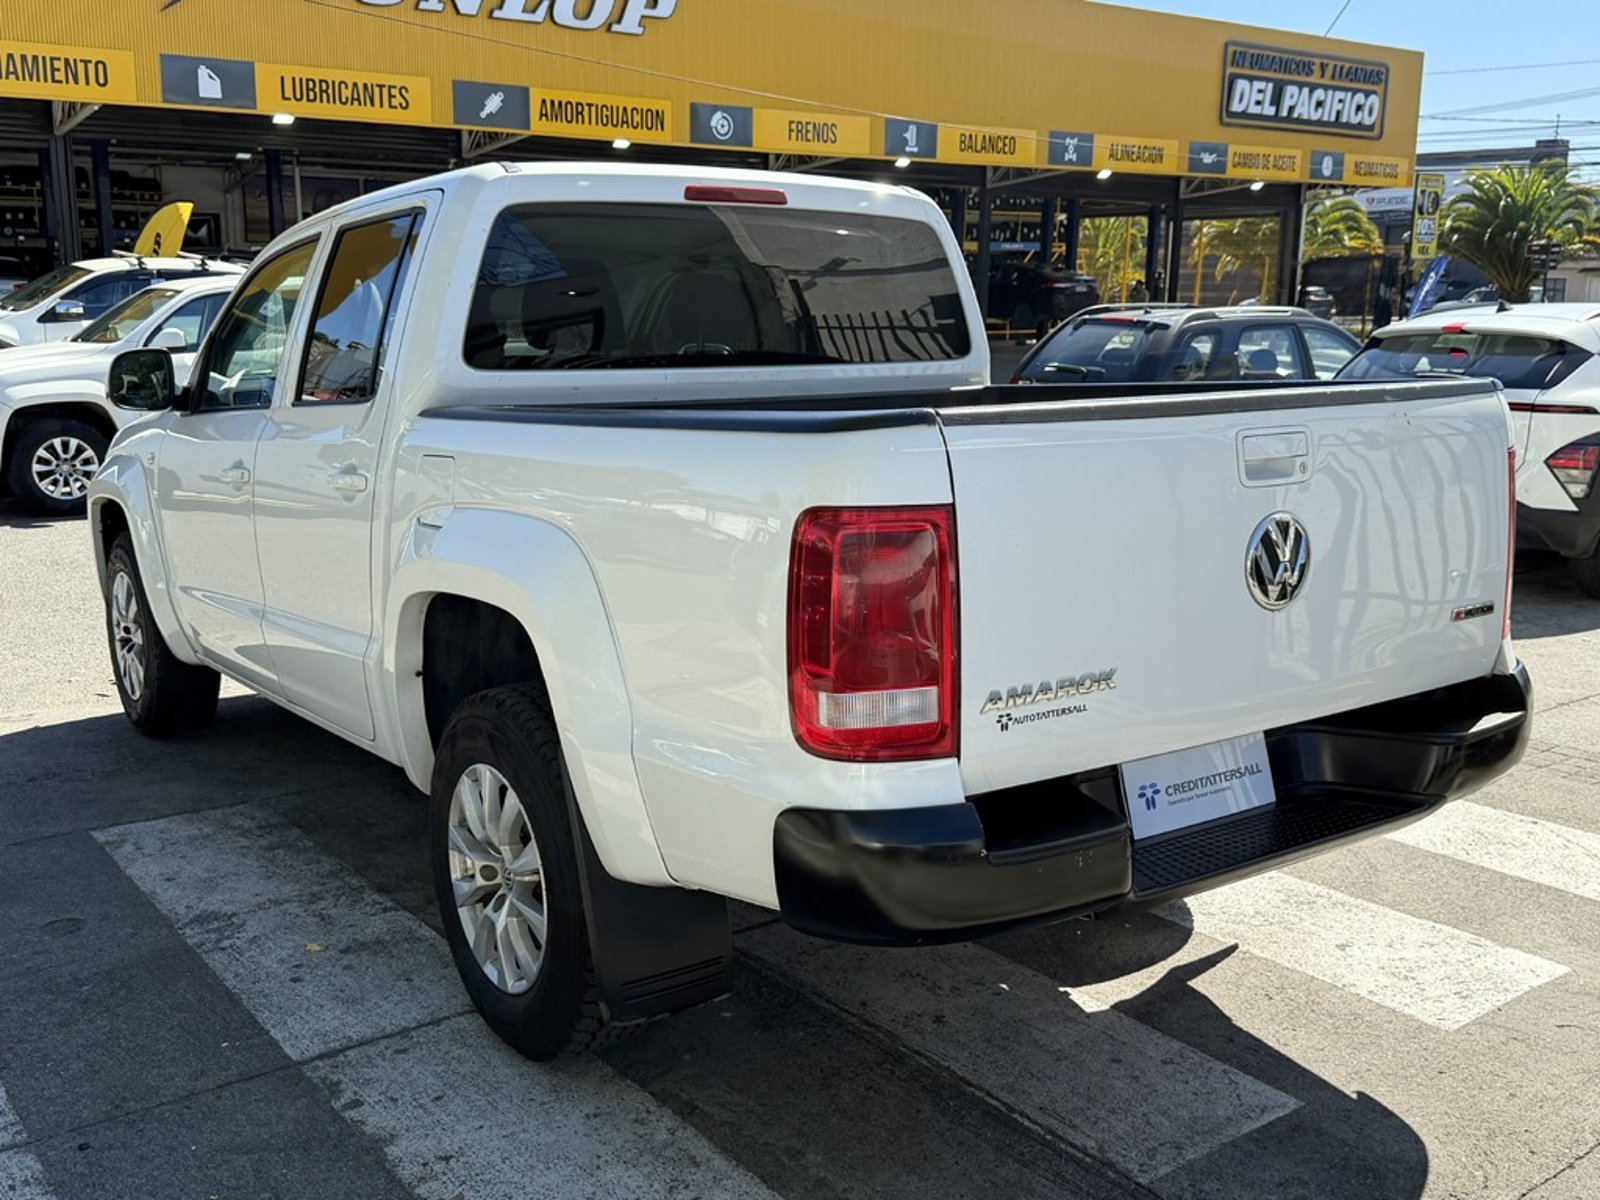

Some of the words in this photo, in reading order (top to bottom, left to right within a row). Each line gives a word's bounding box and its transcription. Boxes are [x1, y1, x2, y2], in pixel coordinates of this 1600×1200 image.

[0, 52, 109, 88] AMIENTO
[1232, 50, 1315, 78] NEUMATICOS
[1319, 61, 1330, 79] Y
[1331, 63, 1385, 86] LLANTAS
[279, 75, 410, 111] LUBRICANTES
[1229, 78, 1277, 116] DEL
[1278, 85, 1380, 126] PACIFICO
[538, 98, 666, 132] AMORTIGUACION
[788, 120, 838, 145] FRENOS
[959, 132, 1017, 156] BALANCEO
[1108, 143, 1165, 165] ALINEACION
[1232, 151, 1260, 170] CAMBIO
[1261, 152, 1271, 171] DE
[1272, 154, 1297, 173] ACEITE
[1353, 160, 1399, 180] NEUMATICOS
[979, 666, 1118, 715] AMAROK
[1012, 704, 1088, 725] AUTOTATTERSALL
[1165, 763, 1263, 797] CREDITATTERSALL
